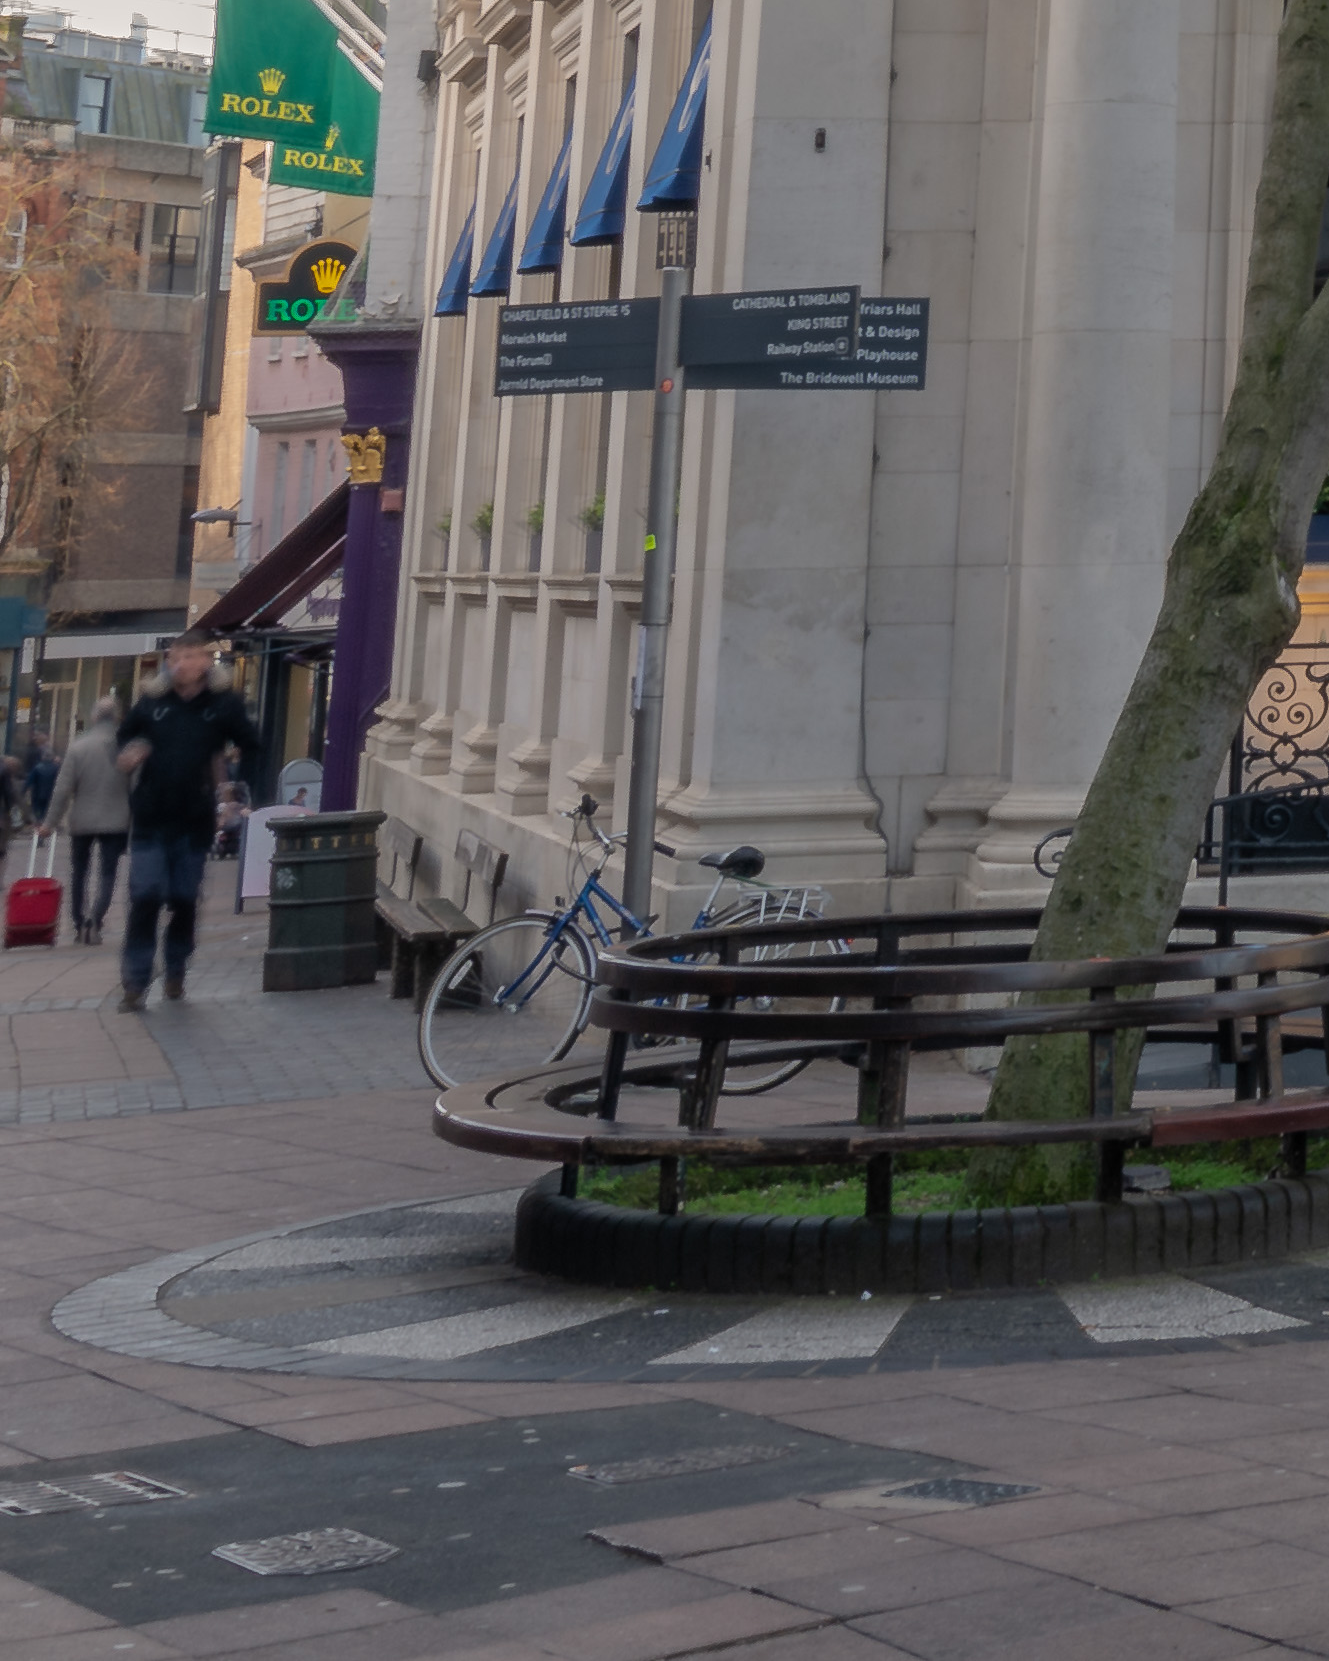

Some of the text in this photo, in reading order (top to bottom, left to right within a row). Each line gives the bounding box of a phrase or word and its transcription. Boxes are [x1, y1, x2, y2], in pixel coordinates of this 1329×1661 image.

[220, 93, 314, 124] ROLEX
[283, 149, 365, 177] ROLEX
[733, 291, 851, 311] CATHEDRAL & TOMBLAND
[266, 298, 358, 322] ROLE
[502, 304, 631, 323] CHAPELFIELD & ST STEPHES
[860, 303, 921, 316] friars Hall
[787, 315, 849, 331] KING STREET
[501, 331, 567, 345] Norwich Market
[866, 326, 875, 338] &
[878, 325, 920, 340] Design
[767, 340, 835, 357] Railway Station
[856, 349, 918, 362] Playhouse
[500, 354, 544, 367] The Forum
[499, 374, 604, 391] Jarrold Department Store
[781, 371, 918, 384] The Bridewell Museum
